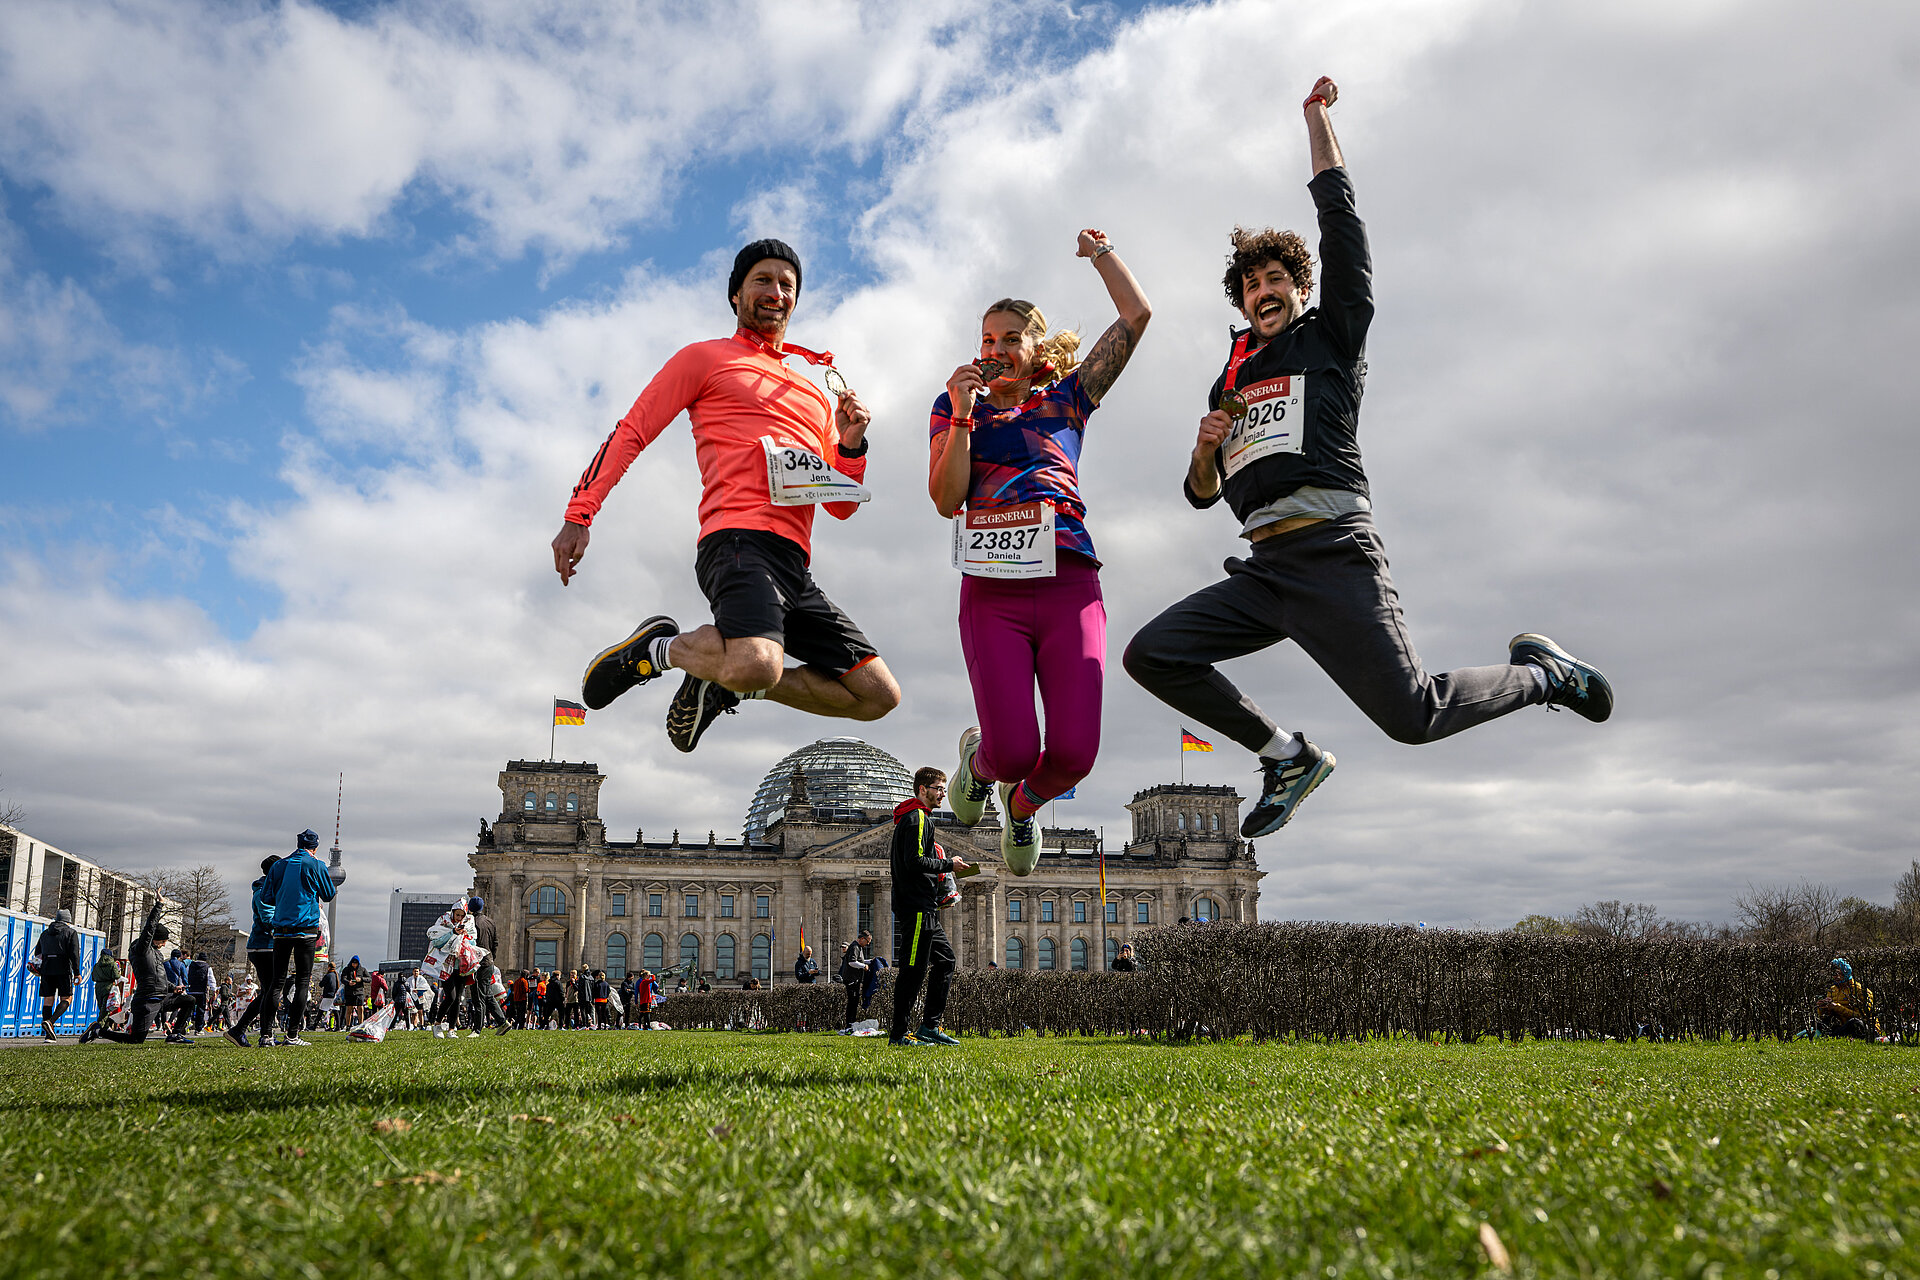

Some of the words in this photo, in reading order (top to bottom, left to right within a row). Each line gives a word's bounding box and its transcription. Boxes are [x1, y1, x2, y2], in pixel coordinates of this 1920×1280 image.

[1243, 428, 1266, 445] Amjad
[810, 473, 831, 482] Jens
[987, 509, 1035, 523] GENERALI
[970, 527, 1039, 550] 23837
[987, 551, 1021, 560] Daniela
